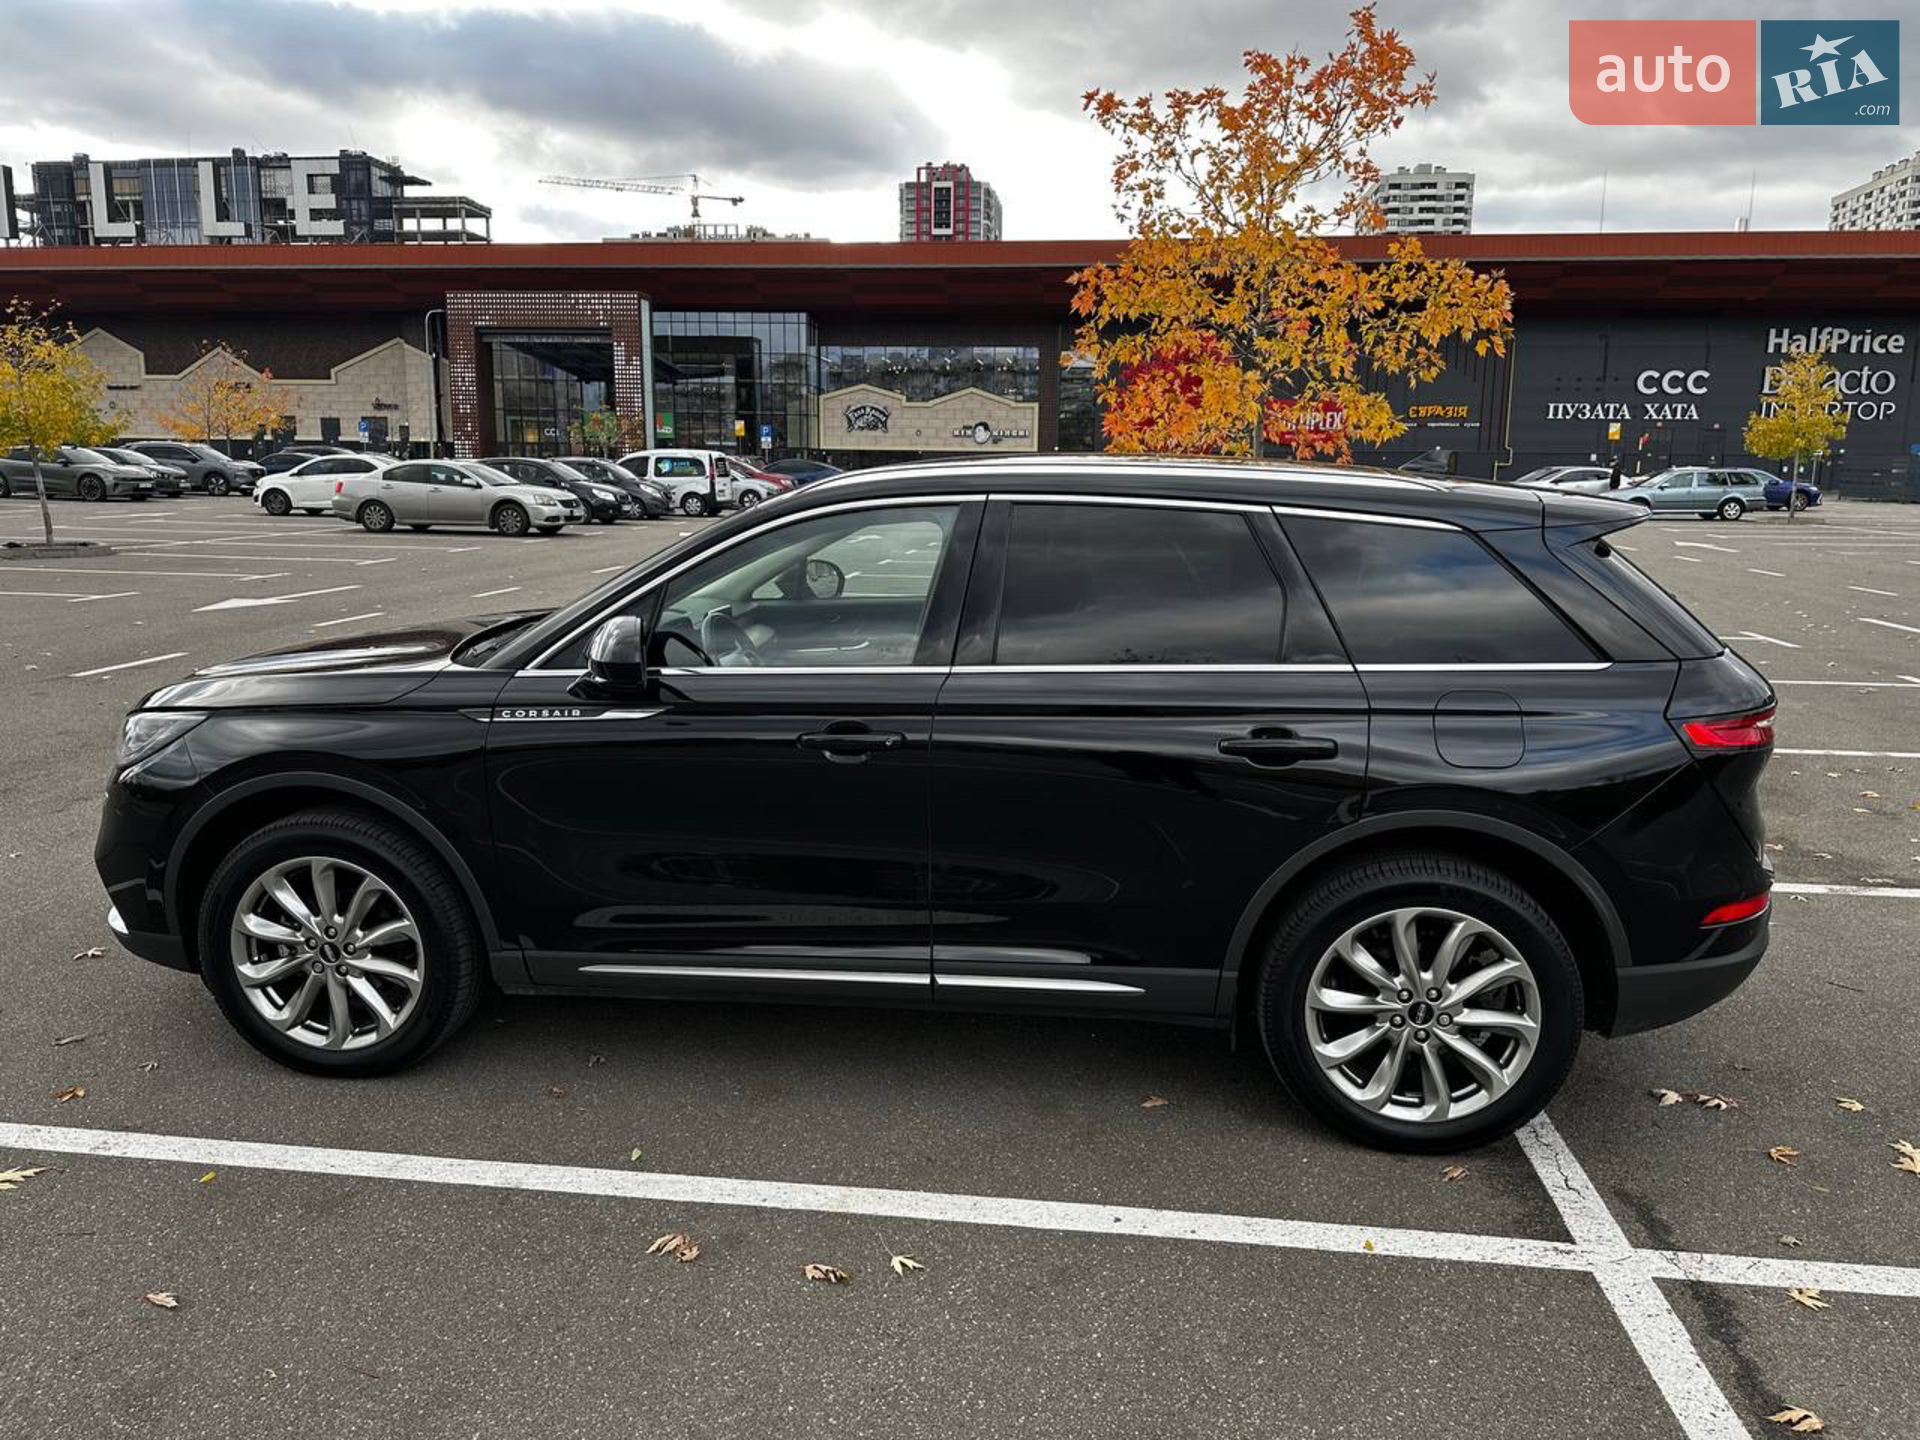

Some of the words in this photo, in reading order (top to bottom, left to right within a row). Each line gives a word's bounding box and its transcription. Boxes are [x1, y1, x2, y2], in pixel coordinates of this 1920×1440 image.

[1767, 326, 1906, 354] HalfPrice
[1636, 370, 1711, 395] CCC
[1547, 403, 1632, 419] ПУЗАТА
[1643, 403, 1700, 420] ХАТА
[1760, 401, 1896, 421] INRTOP
[501, 709, 581, 718] CORSAIR
